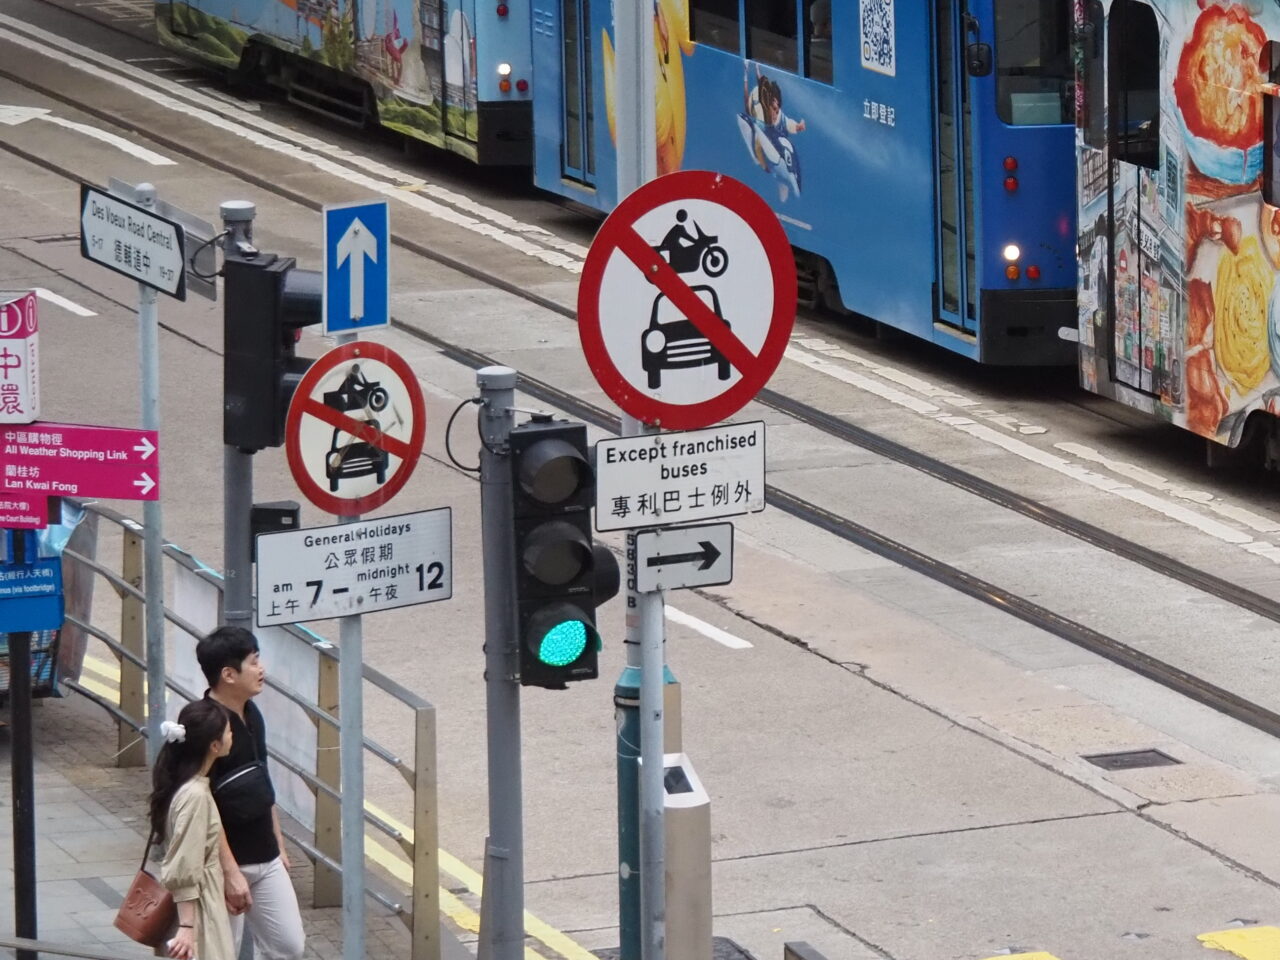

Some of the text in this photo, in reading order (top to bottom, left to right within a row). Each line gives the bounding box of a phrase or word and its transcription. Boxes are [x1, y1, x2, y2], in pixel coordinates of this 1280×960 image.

[863, 98, 896, 127] 立即登記
[92, 200, 173, 251] Des Voeux Road Central
[114, 238, 151, 276] 德輔道中
[5, 446, 128, 461] All Weather Shopping Link
[606, 430, 757, 463] Except franchised
[5, 464, 40, 478] 蘭桂坊
[661, 462, 708, 480] buses
[5, 478, 78, 493] Lan Kwai Fong
[611, 479, 752, 519] 專利巴士例外
[304, 522, 411, 548] General Holidays
[324, 543, 394, 571] 公眾假期
[273, 582, 293, 593] am
[306, 580, 323, 608] 7
[357, 563, 410, 582] midnight
[415, 561, 444, 592] 12
[369, 583, 399, 603] 午夜
[266, 599, 300, 617] 上午
